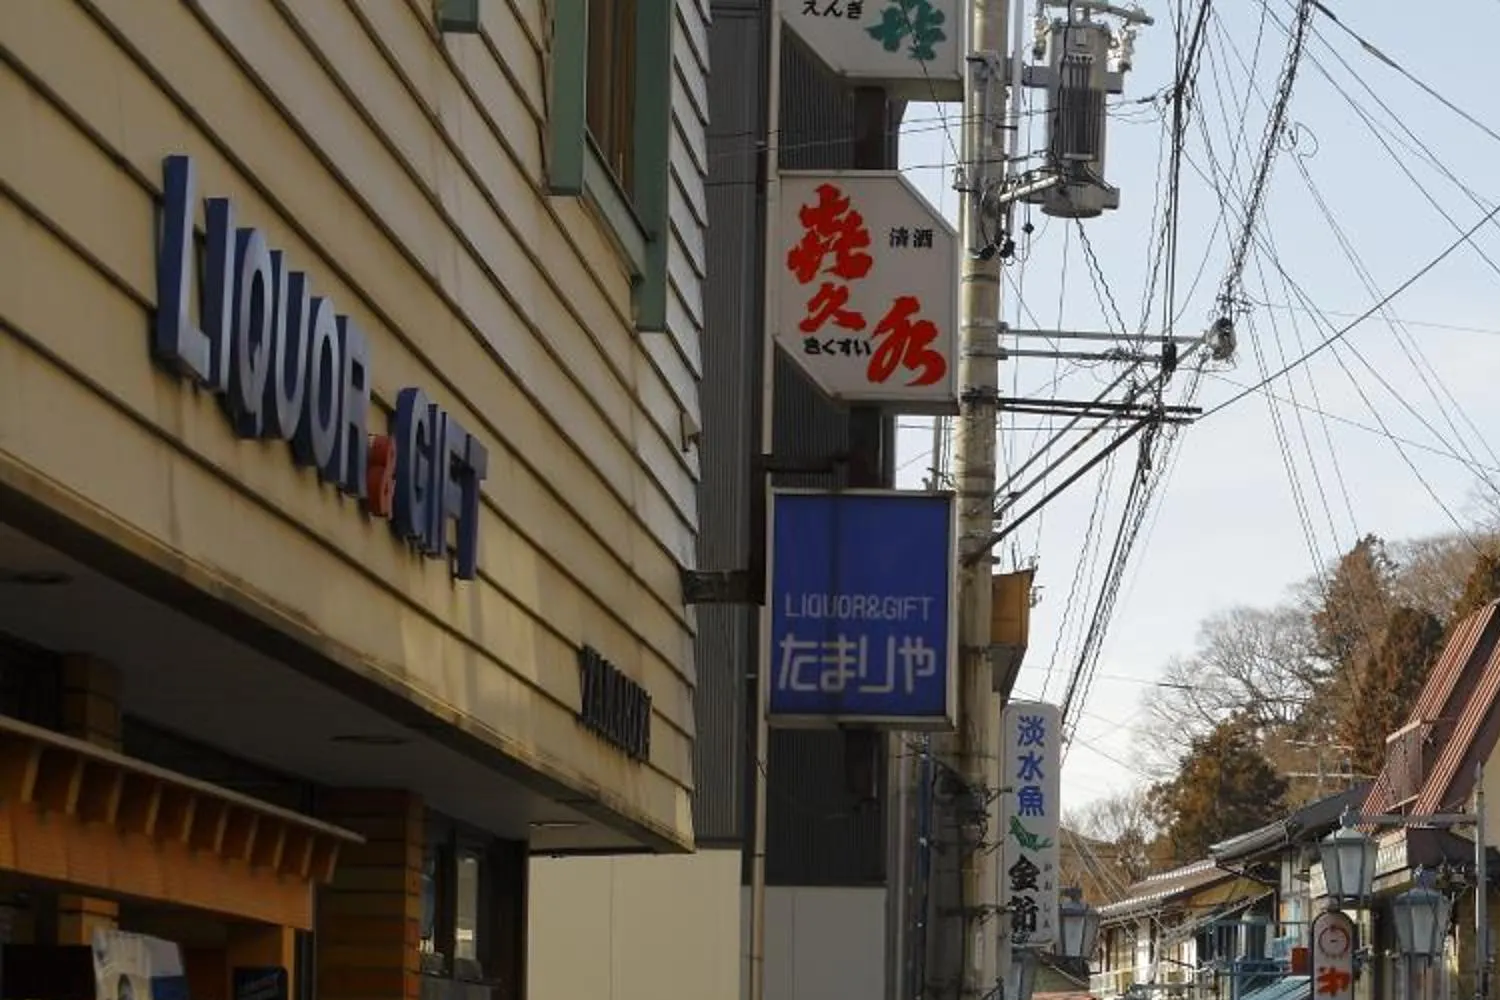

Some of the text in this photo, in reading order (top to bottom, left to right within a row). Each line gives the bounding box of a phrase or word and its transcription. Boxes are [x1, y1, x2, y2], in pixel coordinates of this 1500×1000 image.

[890, 227, 933, 249] 清酒
[156, 155, 488, 580] LIQUOR & GIFT
[804, 337, 872, 356] きくすい
[779, 633, 936, 695] たまりや
[1017, 714, 1045, 817] 淡水魚
